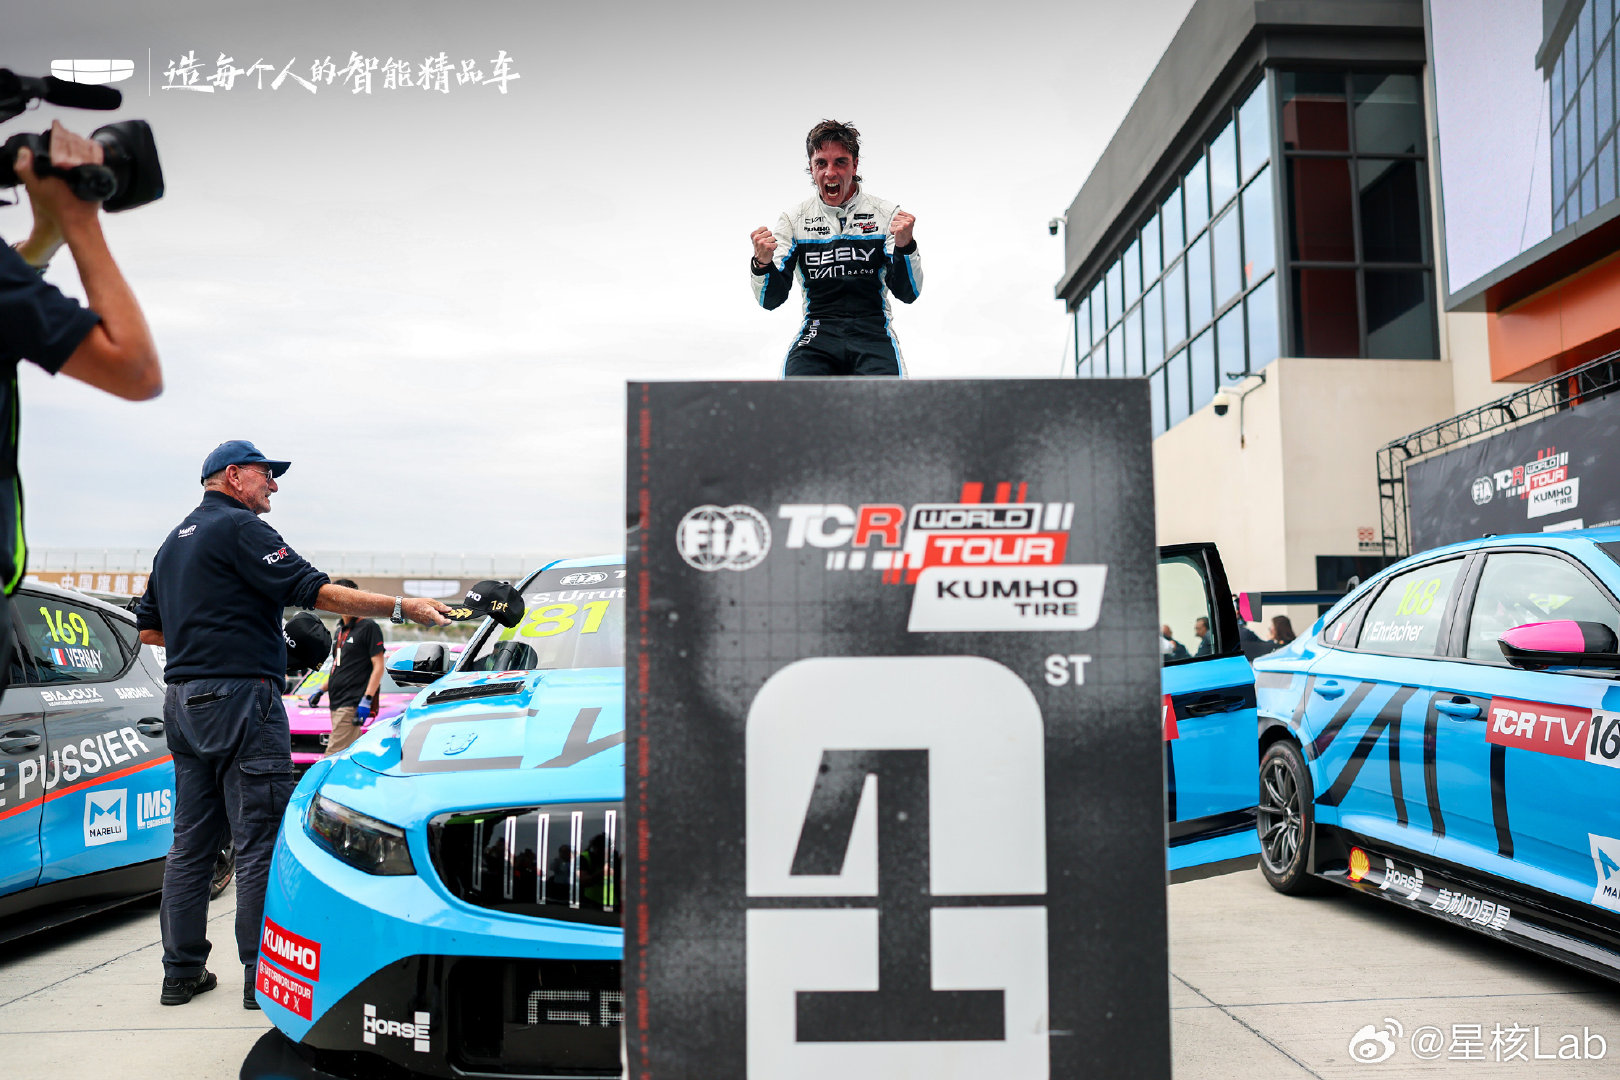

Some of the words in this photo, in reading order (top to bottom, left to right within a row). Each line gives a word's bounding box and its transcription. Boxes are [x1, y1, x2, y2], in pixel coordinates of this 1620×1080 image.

[805, 247, 876, 266] GEELY
[1493, 465, 1525, 491] TCR
[1527, 458, 1558, 474] WORLD
[1532, 469, 1565, 487] TOUR
[1533, 486, 1572, 503] KUMHO
[1555, 497, 1573, 506] TIRE
[778, 503, 906, 549] TCR
[919, 509, 1029, 529] WORLD
[262, 547, 288, 564] TCR
[934, 537, 1055, 564] TOUR
[937, 580, 1079, 599] KUMHO
[1395, 578, 1442, 616] 168
[491, 600, 508, 613] 1st
[1014, 603, 1079, 616] TIRE
[39, 606, 90, 647] 169
[65, 648, 103, 668] VERNAY
[1044, 654, 1092, 686] ST
[1492, 708, 1537, 739] TCR
[1539, 715, 1585, 746] TV
[18, 727, 150, 800] PUSSIER
[137, 789, 171, 827] LMS
[89, 826, 122, 837] MARELLI
[1385, 867, 1424, 893] HORSE
[1429, 888, 1511, 931] 吉利中国星
[263, 926, 317, 971] KUMHO
